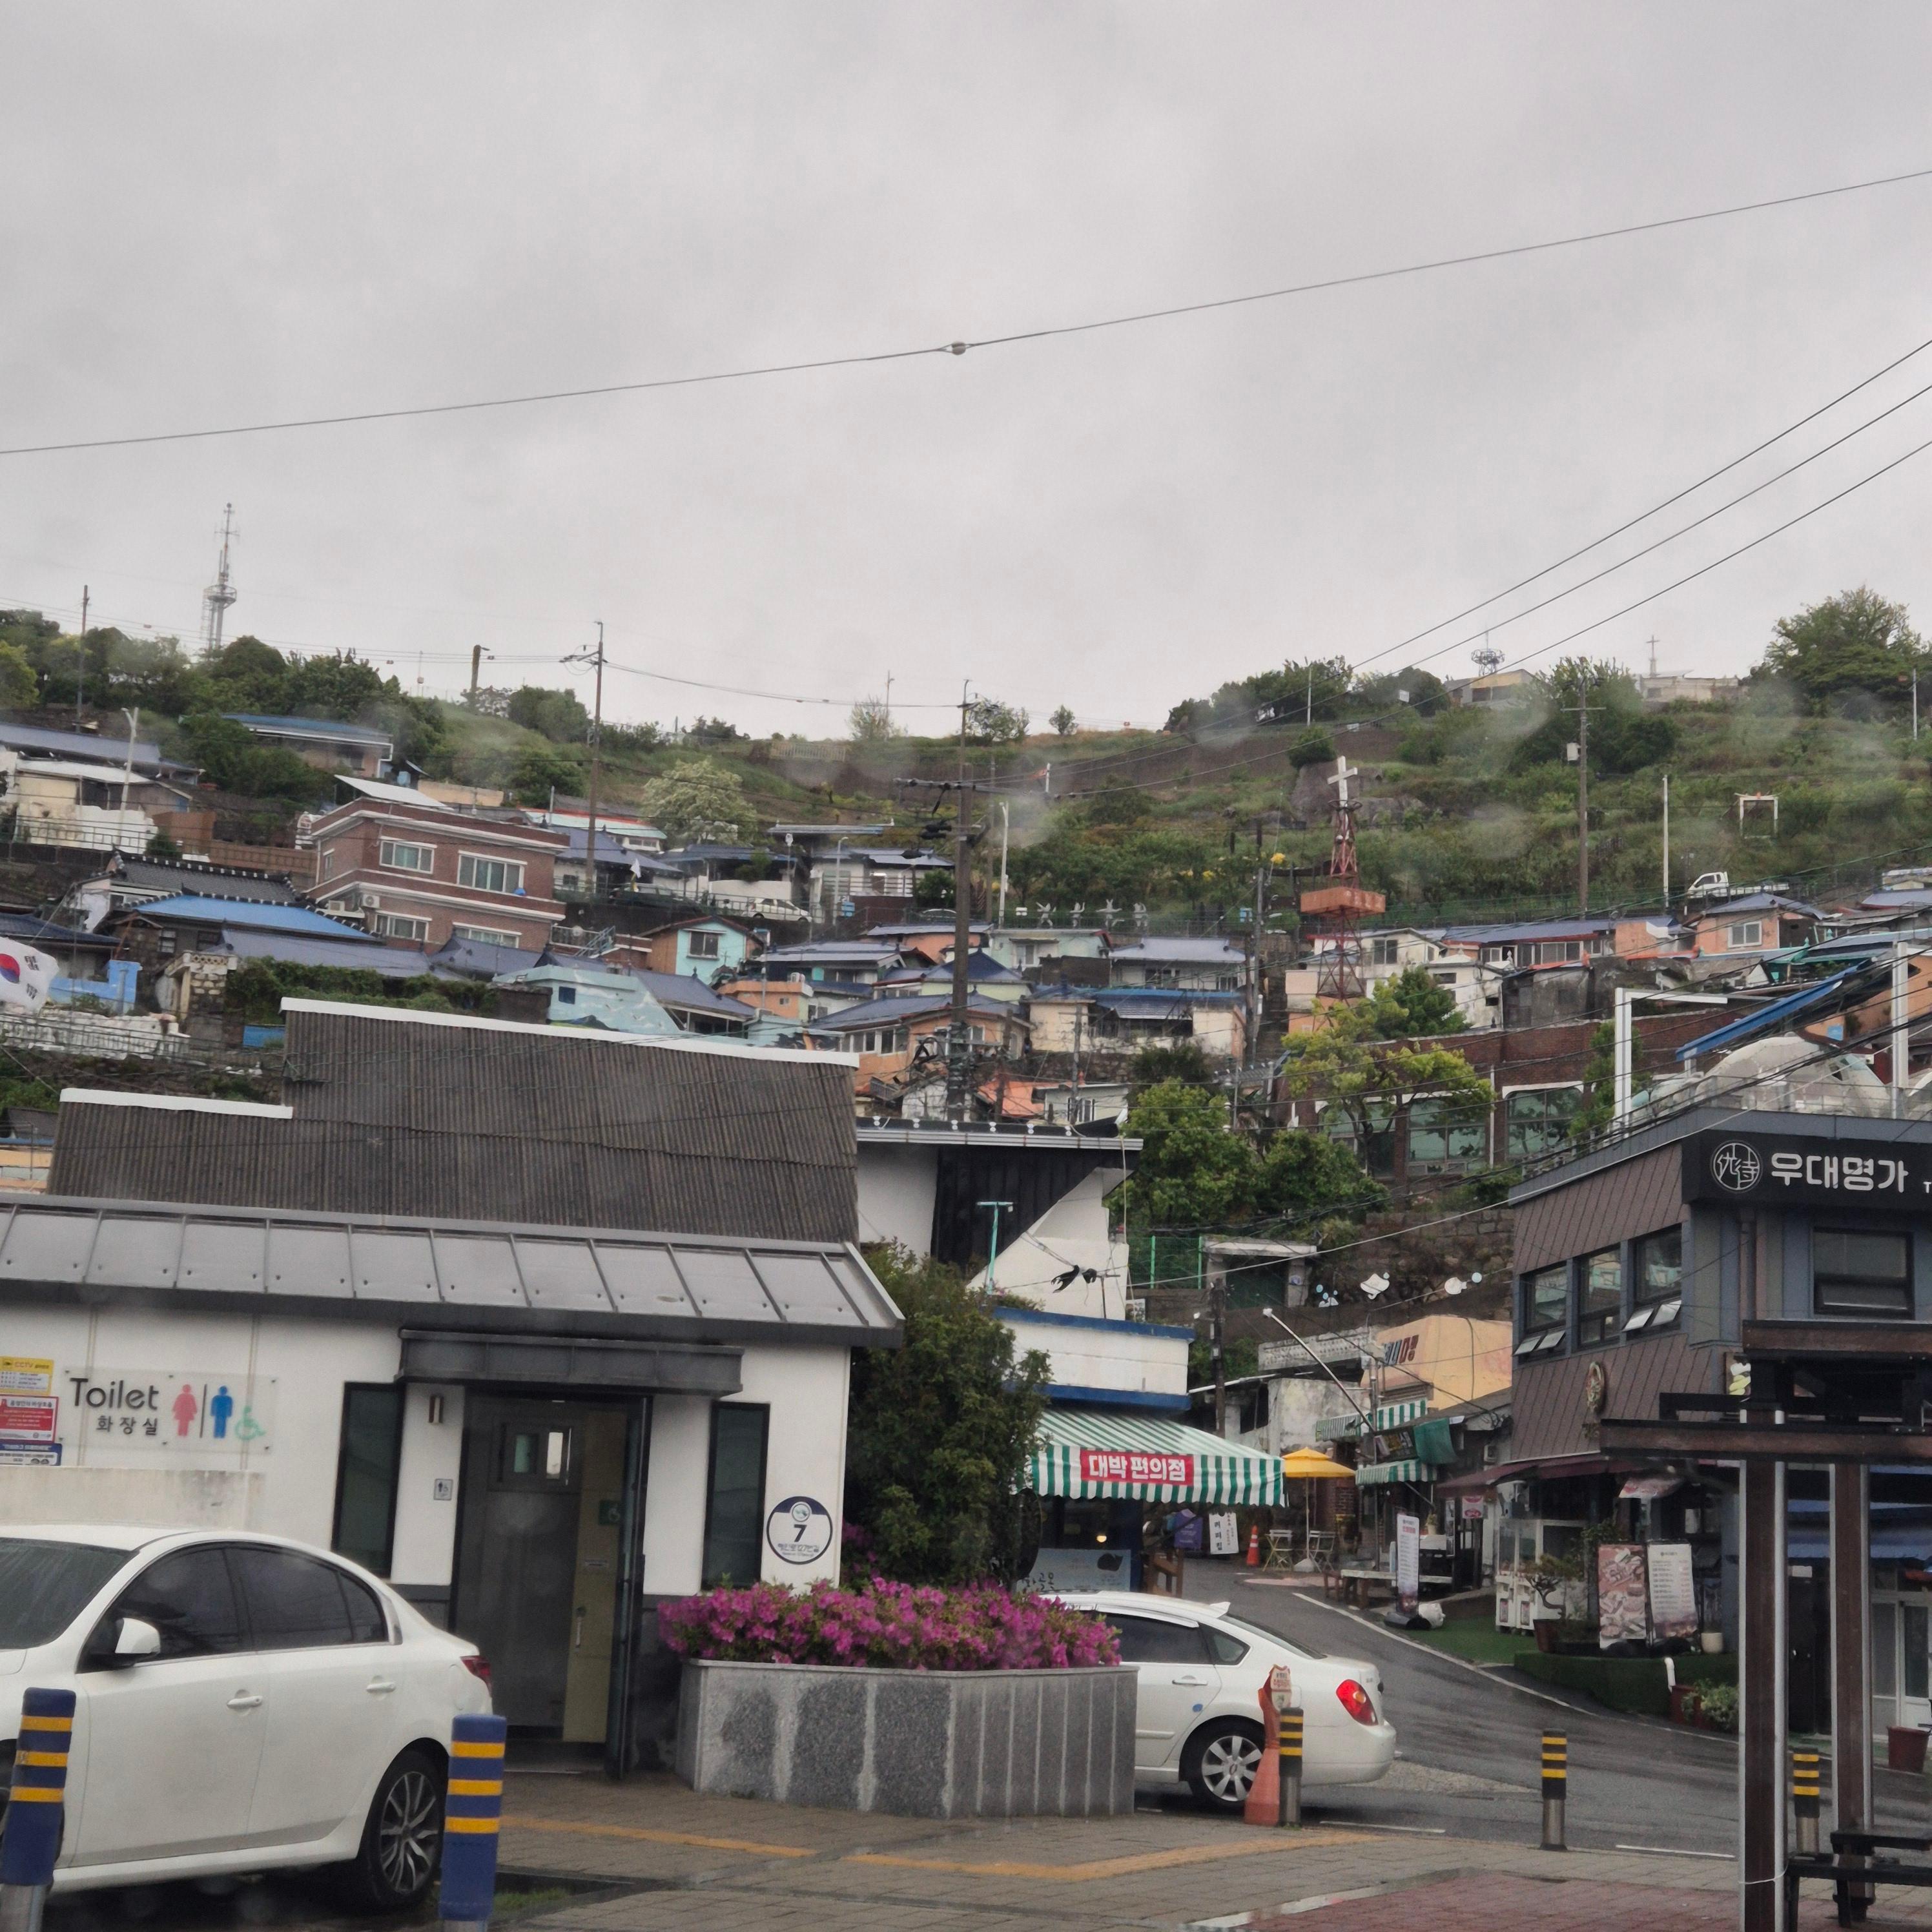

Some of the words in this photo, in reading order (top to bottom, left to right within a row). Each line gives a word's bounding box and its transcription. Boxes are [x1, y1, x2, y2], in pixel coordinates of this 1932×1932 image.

[1771, 1153, 1909, 1193] 우대명가
[70, 1377, 159, 1410] Toilet
[96, 1414, 158, 1436] 화장실
[1089, 1454, 1126, 1479] 대박
[1131, 1456, 1186, 1482] 편의점
[794, 1524, 807, 1543] 7
